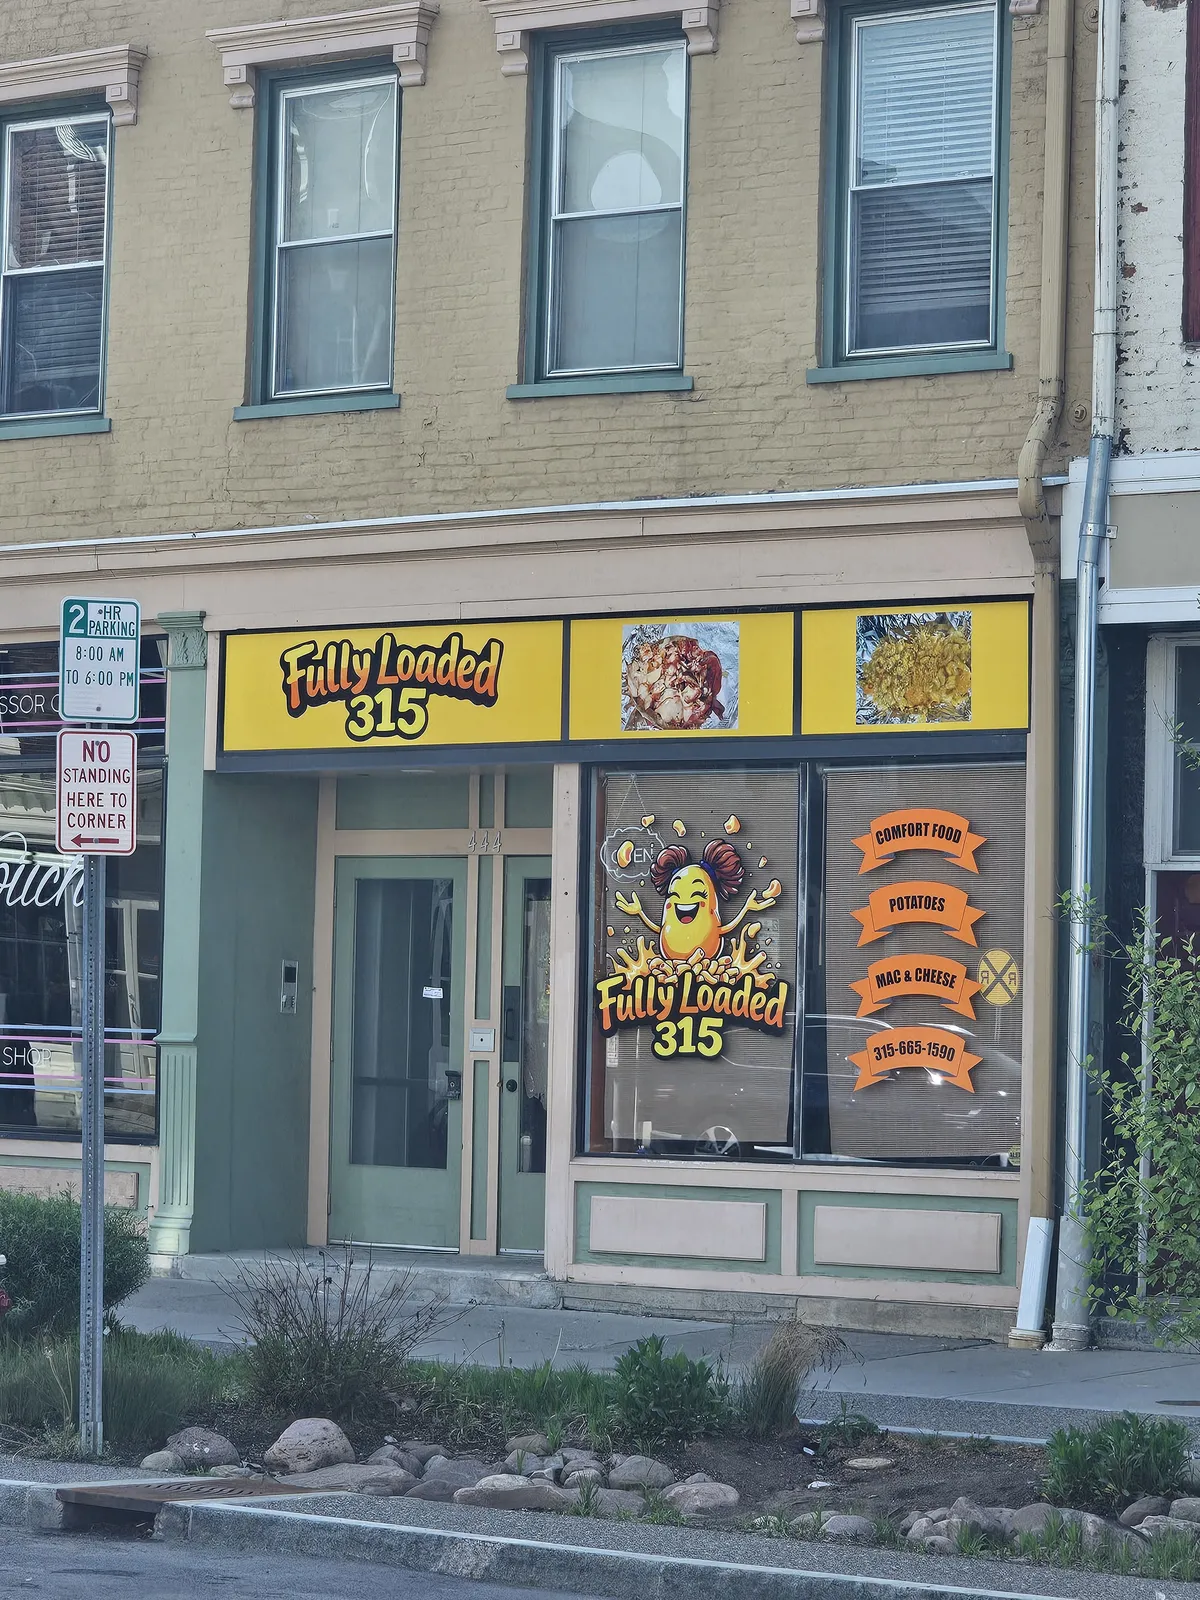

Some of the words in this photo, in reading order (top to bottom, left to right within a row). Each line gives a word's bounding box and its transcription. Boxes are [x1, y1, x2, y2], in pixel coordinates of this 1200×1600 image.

[68, 604, 85, 634] 2
[103, 606, 121, 620] HR
[89, 621, 135, 637] PARKING
[76, 646, 103, 662] 8:00
[109, 647, 124, 662] AM
[66, 669, 79, 685] TO
[85, 670, 113, 686] 6:00
[120, 671, 134, 687] PM
[283, 641, 371, 709] Fully
[377, 634, 501, 697] Loaded
[348, 687, 427, 737] 315
[83, 740, 110, 763] NO
[63, 768, 131, 784] STANDING
[67, 791, 104, 808] HERE
[110, 792, 127, 808] TO
[67, 812, 126, 829] CORNER
[468, 830, 502, 853] 444
[875, 822, 930, 845] COMFORT
[932, 823, 962, 844] FOOD
[611, 848, 653, 864] EN
[889, 895, 946, 913] POTATOES
[875, 969, 901, 989] MAC
[904, 970, 912, 982] &
[915, 967, 957, 989] CHEESE
[596, 976, 674, 1030] Fully
[678, 972, 788, 1028] Loaded
[654, 1016, 723, 1057] 315
[3, 1046, 52, 1067] SHOP
[873, 1040, 956, 1062] 315-665-1590
